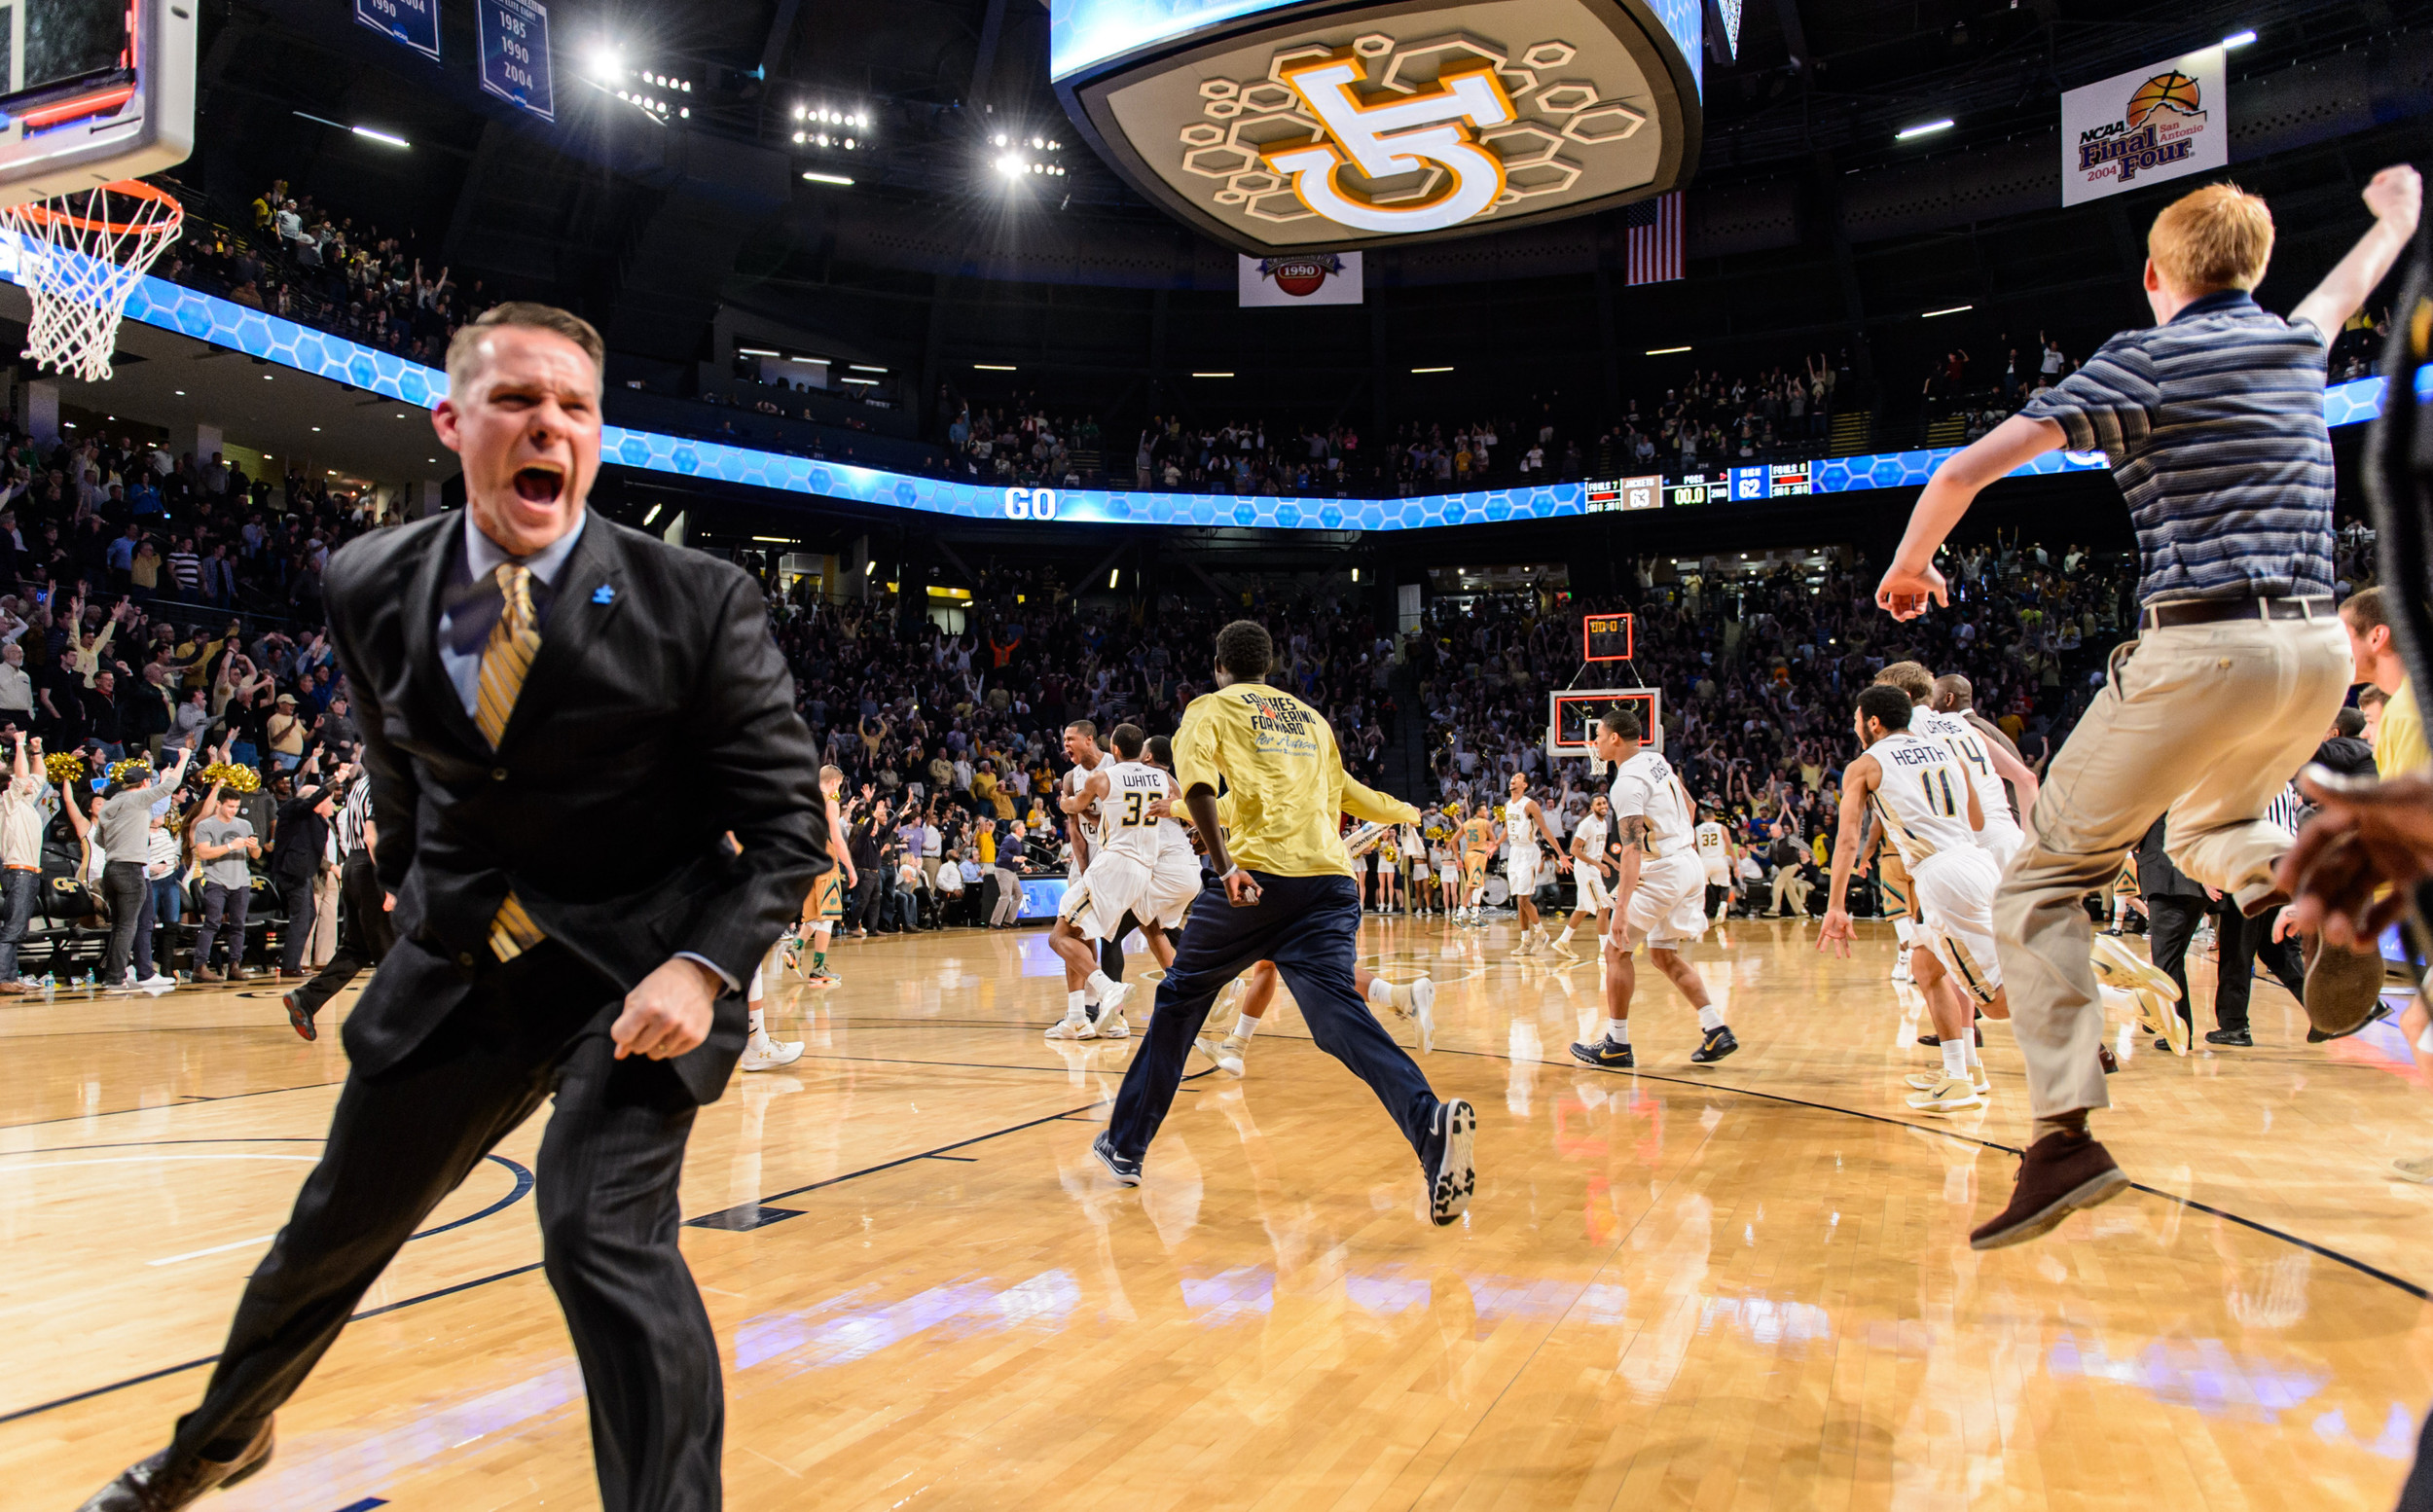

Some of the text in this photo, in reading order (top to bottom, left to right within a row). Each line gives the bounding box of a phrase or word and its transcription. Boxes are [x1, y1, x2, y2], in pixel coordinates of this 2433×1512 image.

[499, 11, 527, 38] 1985
[501, 35, 529, 64] 1990
[504, 61, 533, 90] 2004
[2080, 121, 2124, 144] NCAA
[2159, 125, 2204, 143] Antonio
[2160, 122, 2180, 133] San
[2079, 124, 2158, 171] Final
[2118, 138, 2193, 182] Four
[2088, 165, 2118, 182] 2004
[1284, 266, 1315, 276] 1990
[1773, 464, 1798, 475] FOULS
[1588, 481, 1618, 492] FOULS 7
[1624, 477, 1655, 488] JACKETS
[1684, 474, 1705, 485] POSS
[1738, 478, 1761, 498] 62
[1005, 487, 1056, 520] GO
[1629, 488, 1651, 508] 63
[1674, 486, 1705, 505] 00.0
[1241, 693, 1297, 711] COACHES
[1255, 702, 1317, 725] PWERING
[1251, 715, 1306, 736] FORWARD
[1254, 732, 1275, 745] for
[1890, 746, 1948, 766] HEATH
[1122, 774, 1161, 787] WHITE
[1919, 767, 1956, 817] 11
[1467, 829, 1479, 843] 35
[1701, 833, 1718, 846] 32
